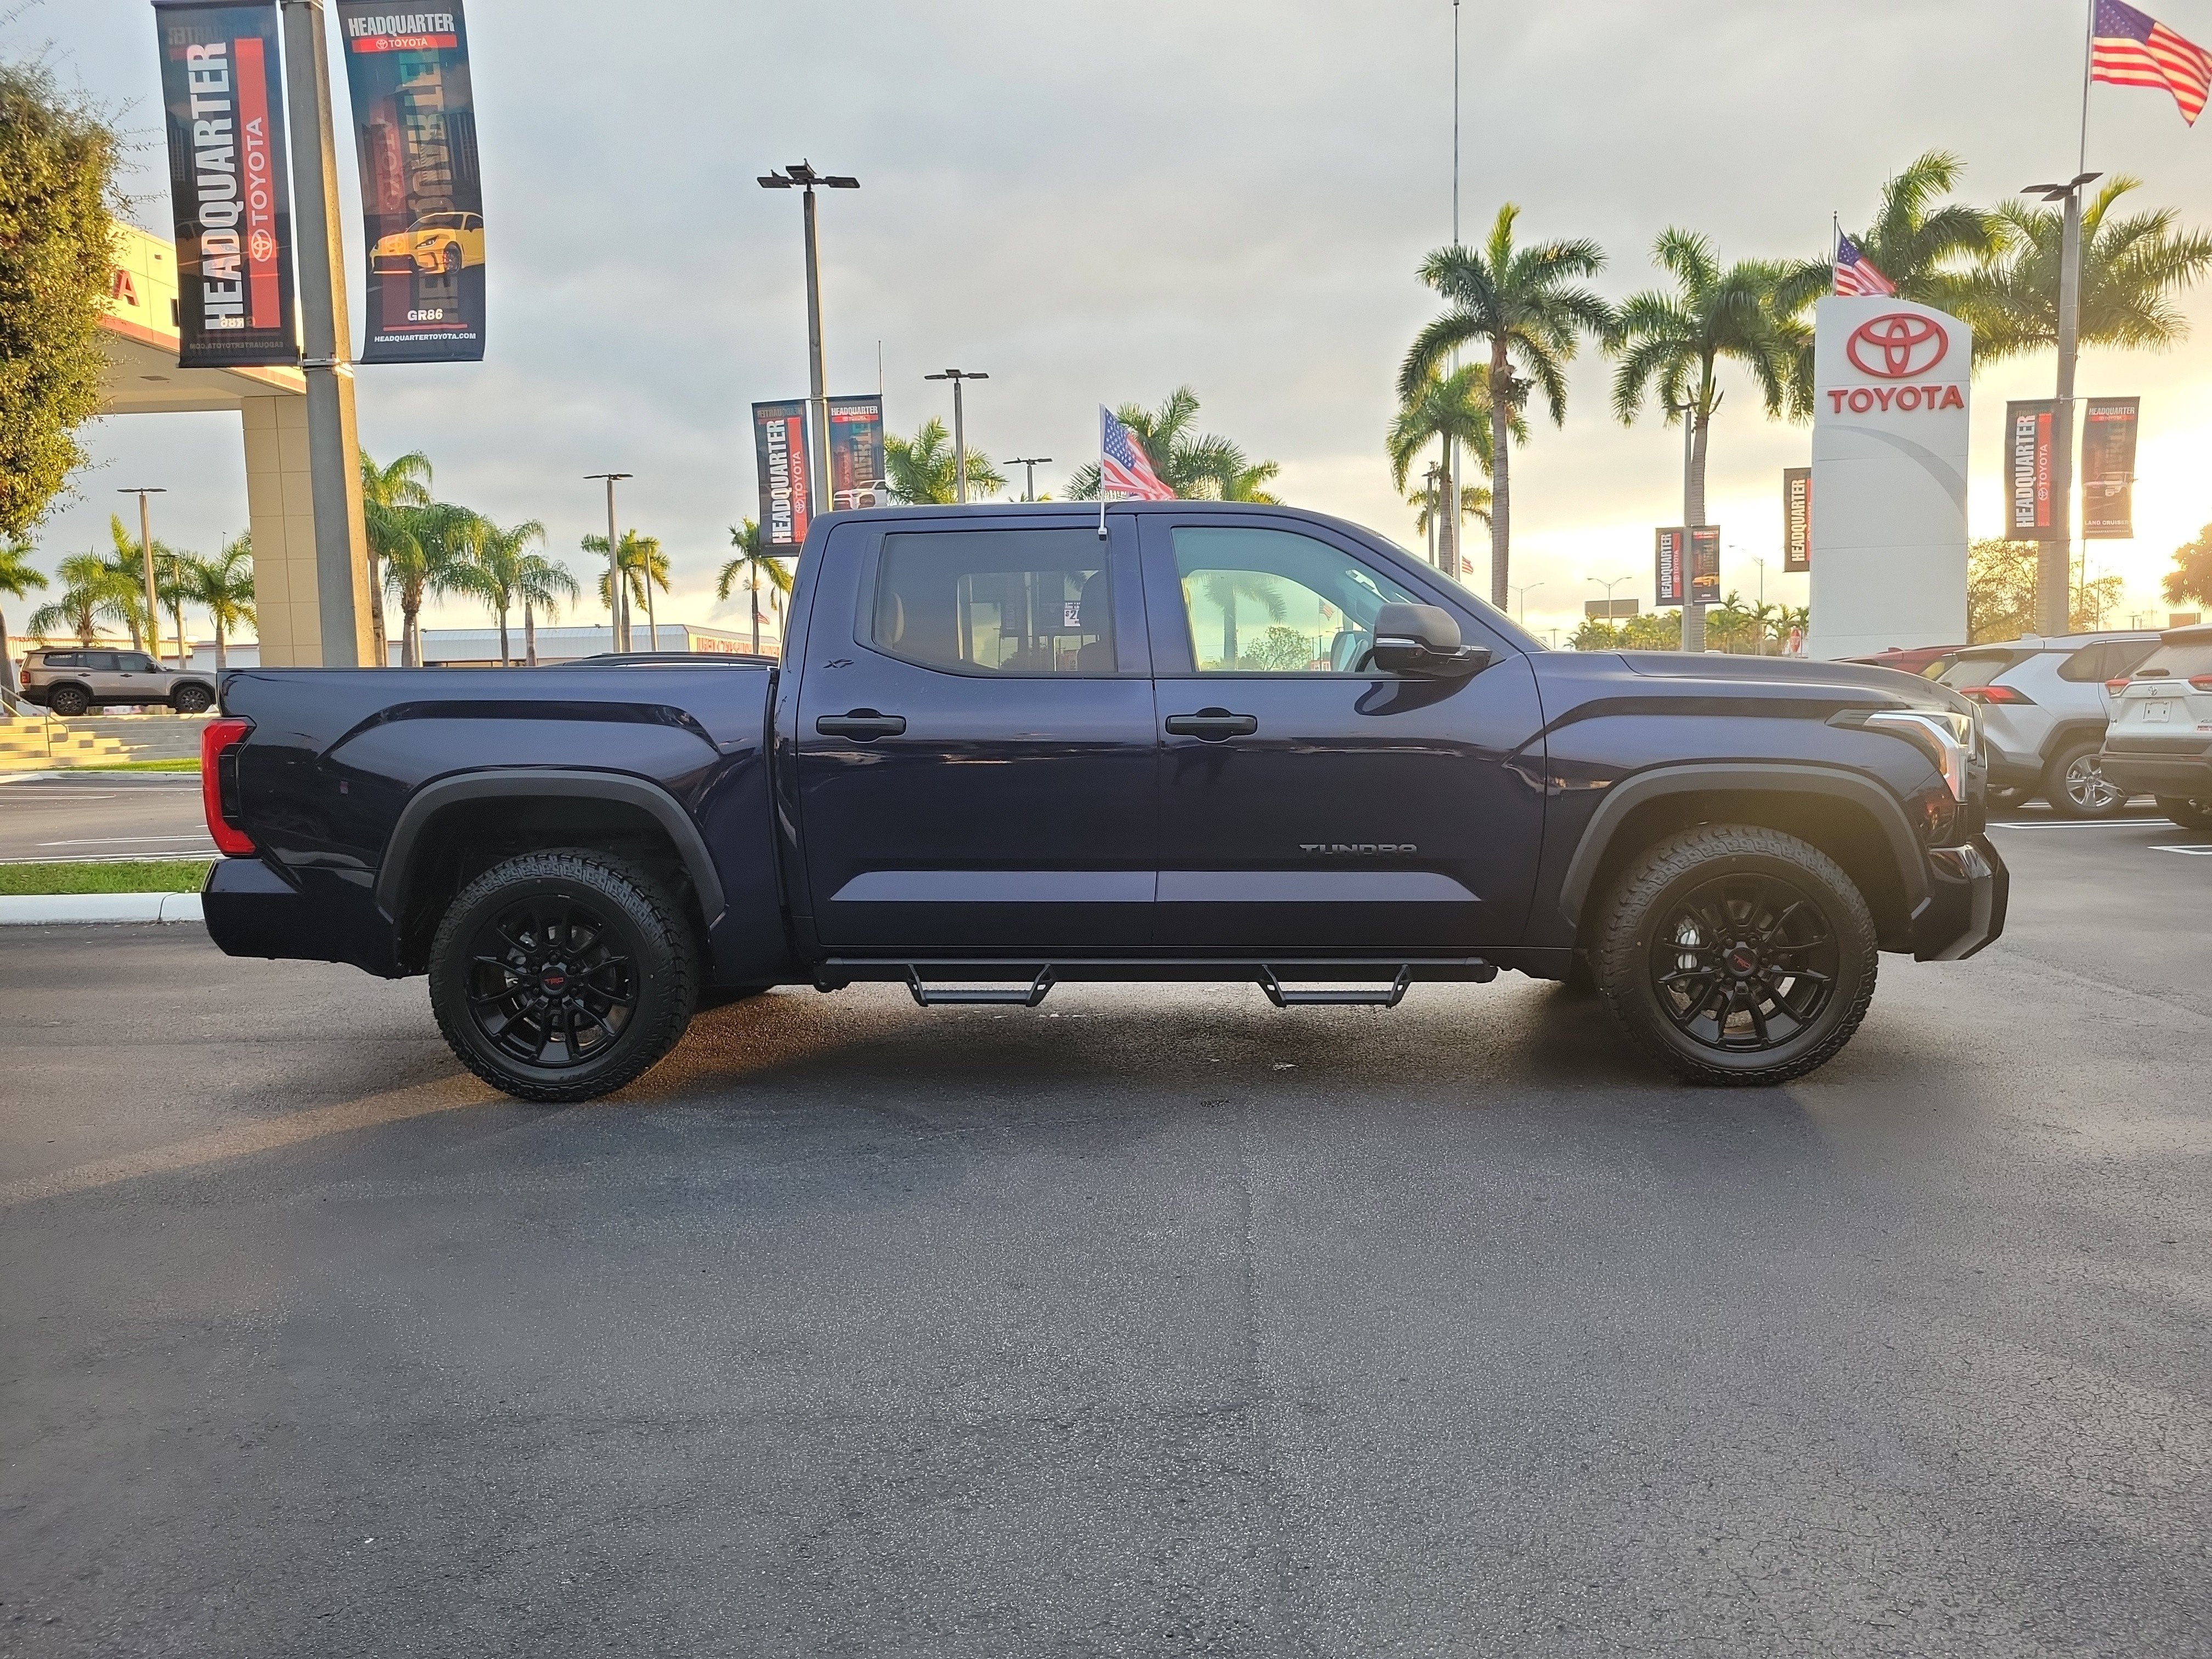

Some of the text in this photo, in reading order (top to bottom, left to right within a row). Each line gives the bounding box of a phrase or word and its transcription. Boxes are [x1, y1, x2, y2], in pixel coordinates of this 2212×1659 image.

[348, 14, 455, 37] HEADQUARTER
[388, 37, 428, 48] TOYOTA
[187, 42, 244, 329] HEADQUARTER
[246, 117, 268, 226] TOYOTA
[408, 309, 443, 321] GR86
[374, 332, 476, 342] HEADQUARTERTOYOTA.COM
[831, 406, 878, 416] HEADQUARTER
[1827, 386, 1965, 414] TOYOTA
[2089, 407, 2135, 415] HEADQUARTER
[766, 419, 792, 544] HEADQUARTER
[792, 451, 804, 499] TOYOTA
[2016, 415, 2036, 527] HEADQUARTER
[2039, 444, 2048, 487] TOYOTA
[1791, 479, 1807, 561] HEADQUARTER
[1661, 534, 1673, 598] HEADQUARTER
[1299, 844, 1417, 855] TUNDRA
